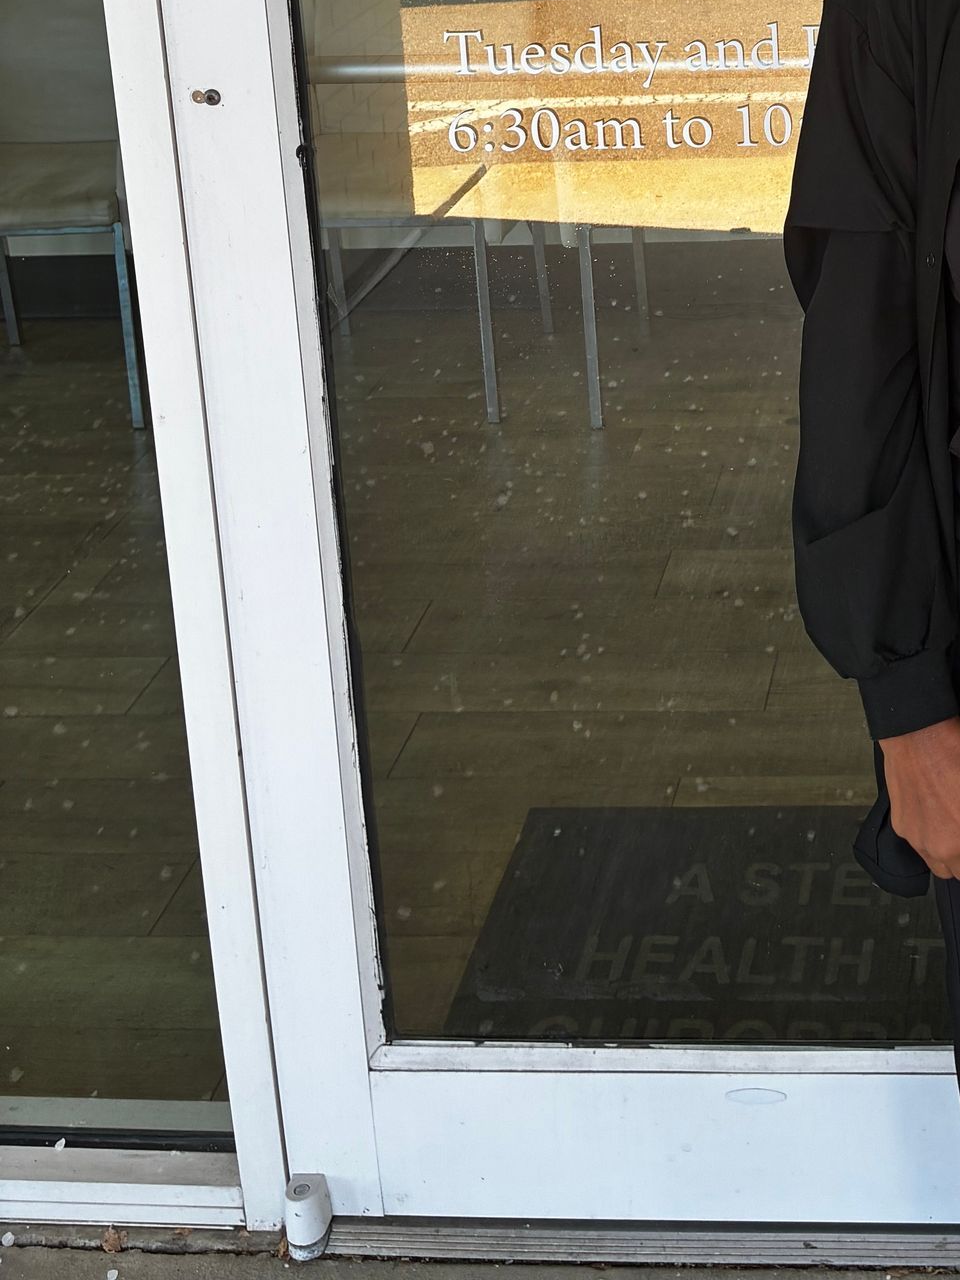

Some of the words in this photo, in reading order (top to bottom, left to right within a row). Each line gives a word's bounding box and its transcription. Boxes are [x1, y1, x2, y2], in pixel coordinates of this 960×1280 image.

[443, 24, 669, 89] Tuesday
[683, 21, 785, 72] and
[448, 107, 646, 152] 6:30am
[662, 108, 714, 149] to
[664, 861, 715, 905] A
[741, 861, 890, 906] STE
[573, 936, 876, 986] HEALTH
